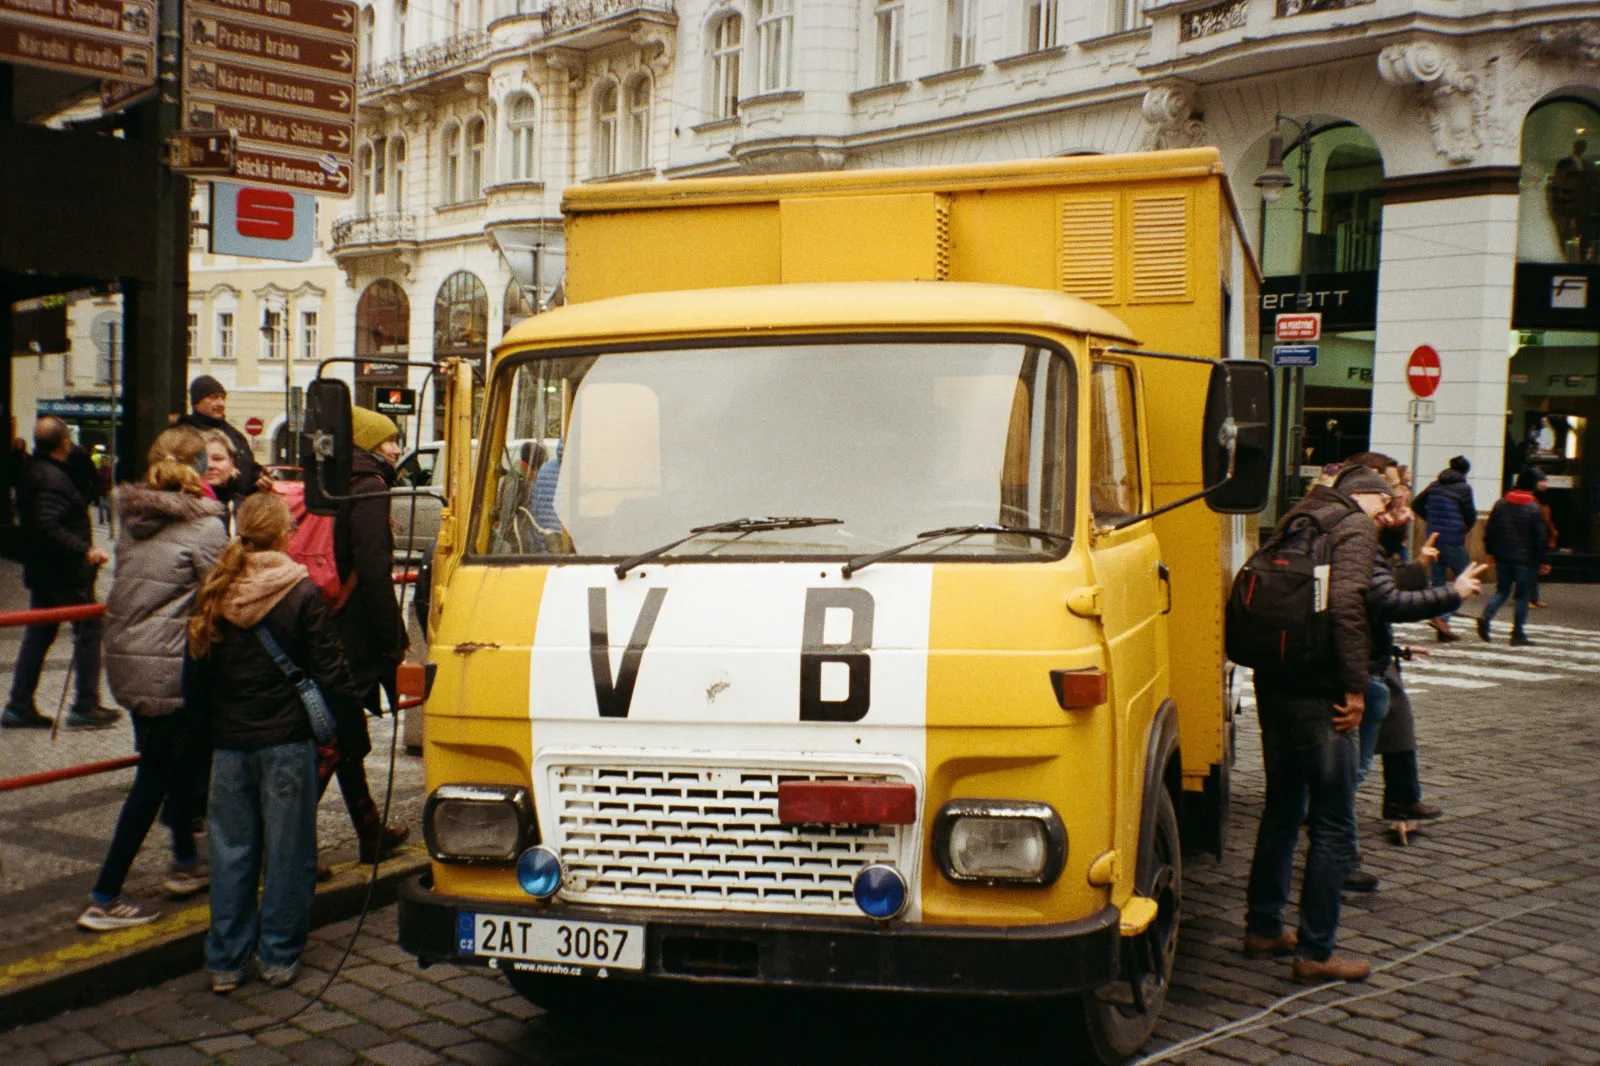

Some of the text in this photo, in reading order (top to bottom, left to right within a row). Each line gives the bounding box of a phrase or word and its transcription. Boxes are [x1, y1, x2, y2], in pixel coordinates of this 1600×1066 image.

[74, 42, 121, 69] divadlo
[218, 26, 299, 59] Prašná brána
[217, 68, 315, 103] Národní muzeum
[261, 118, 288, 140] Marie
[236, 159, 270, 179] stické
[271, 162, 325, 186] informace
[587, 587, 876, 722] V B
[460, 939, 473, 951] CZ
[482, 919, 629, 962] 2AT 3067
